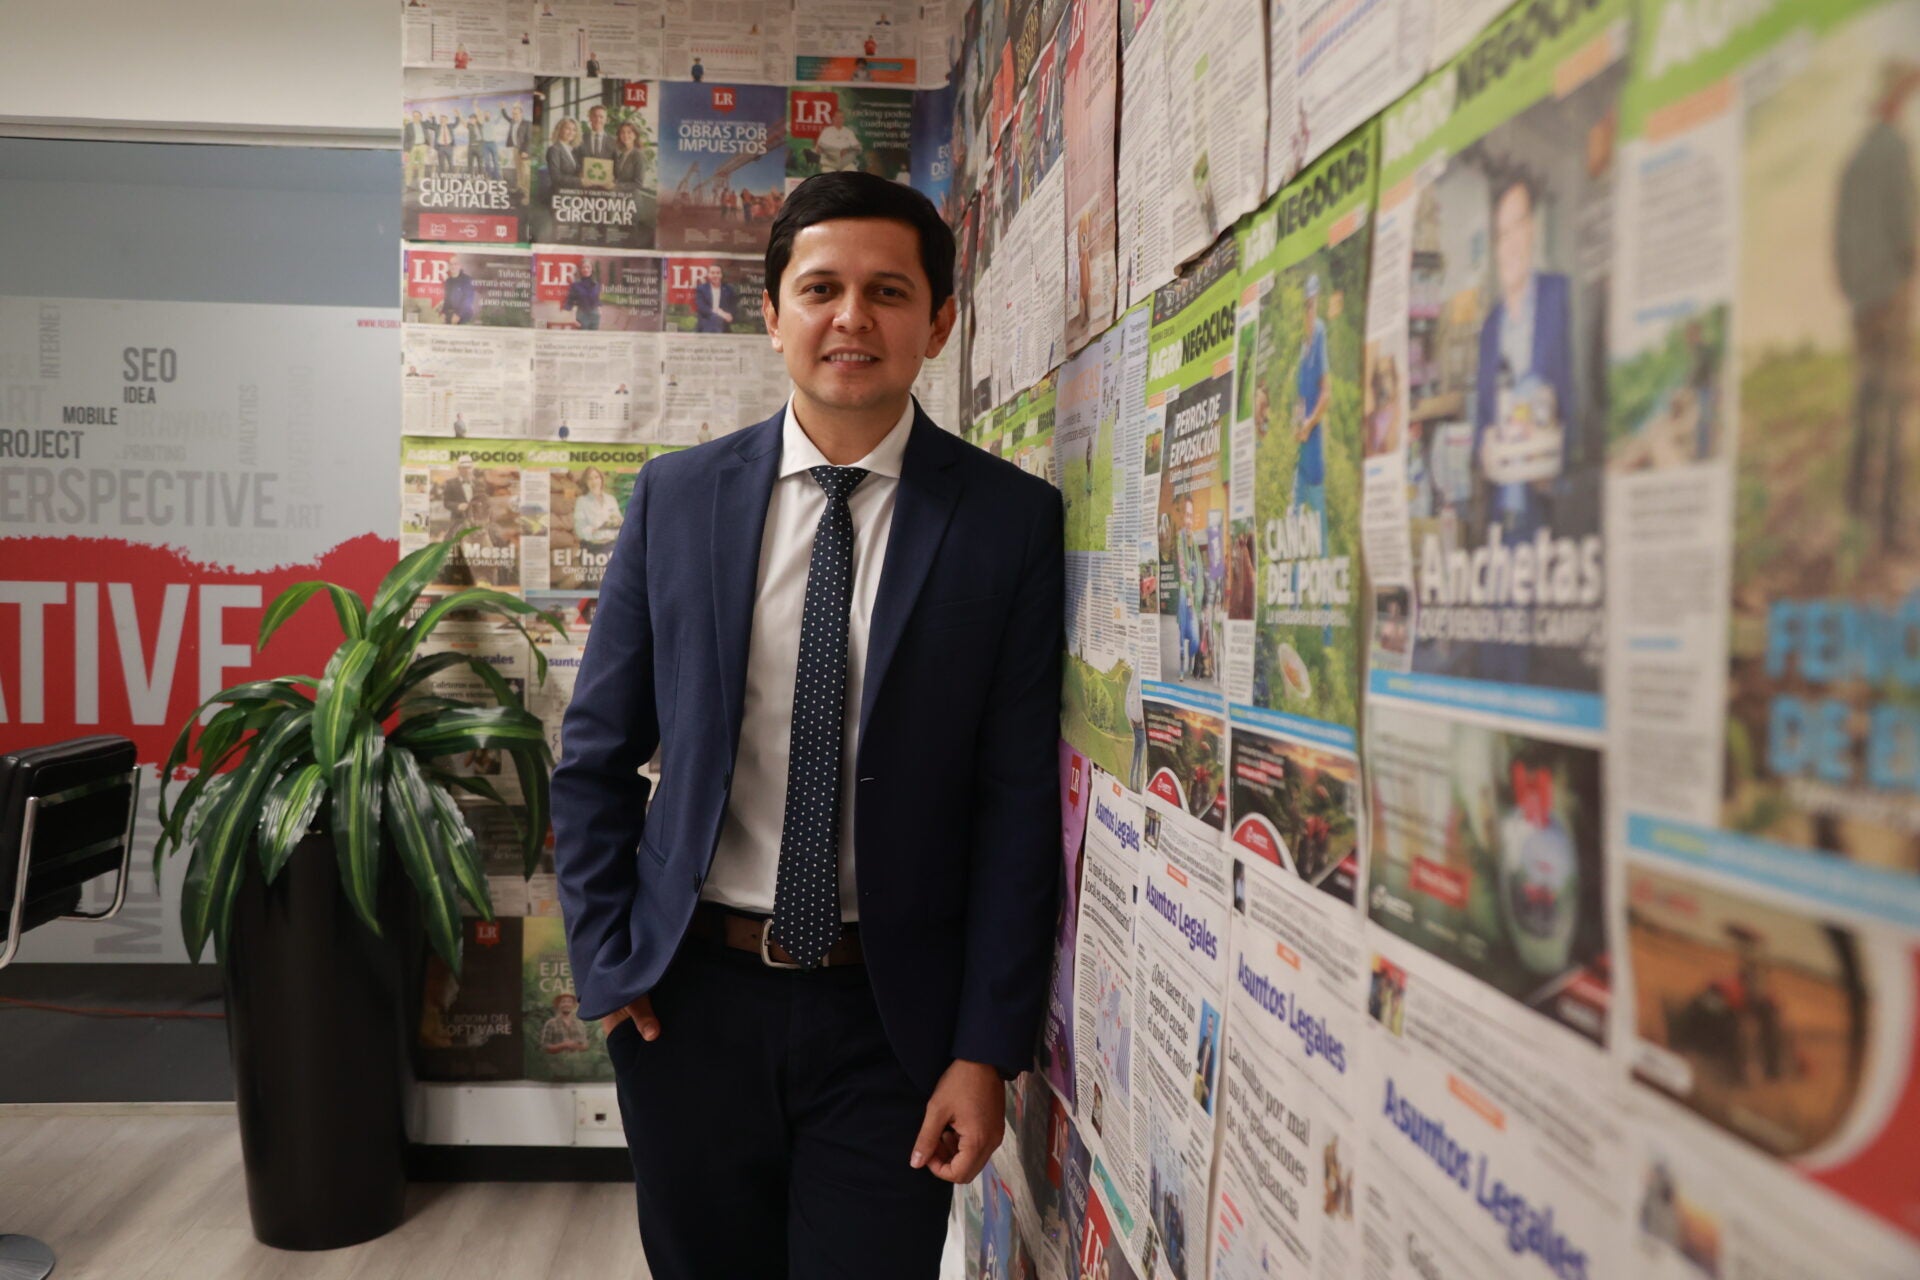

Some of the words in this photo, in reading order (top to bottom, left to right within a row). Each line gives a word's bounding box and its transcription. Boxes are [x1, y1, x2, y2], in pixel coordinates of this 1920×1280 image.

[626, 88, 645, 102] LR
[714, 92, 734, 106] LR
[795, 99, 833, 125] LR
[679, 124, 731, 139] OBRAS
[736, 127, 768, 140] POR
[678, 138, 768, 155] IMPUESTOS
[419, 177, 508, 197] CIUDADES
[419, 192, 511, 210] CAPITALES
[551, 194, 638, 214] ECONOMÍA
[555, 208, 633, 226] CIRCULAR
[412, 258, 449, 284] LR
[540, 261, 577, 286] LR
[672, 265, 708, 289] LR
[38, 302, 62, 380] INTERNET
[123, 345, 178, 384] SEO
[123, 386, 157, 405] IDEA
[62, 405, 119, 427] MOBILE
[238, 382, 260, 467] ANALYTICS
[1174, 399, 1208, 438] PERROS
[1207, 393, 1222, 424] DE
[0, 428, 85, 460] ROJECT
[1169, 423, 1221, 469] EXPOSICIÓN
[0, 465, 279, 528] ERSPECTIVE
[284, 503, 324, 530] ART
[463, 542, 516, 559] Messi
[553, 548, 571, 566] El
[1420, 522, 1603, 605] Anchetas
[0, 580, 262, 726] TIVE
[549, 656, 582, 668] sunto
[1070, 765, 1080, 794] LR
[1094, 795, 1115, 832] Asuntos
[1114, 811, 1140, 853] Legales
[1145, 875, 1177, 928] Asuntos
[1178, 902, 1218, 961] Legales
[477, 925, 498, 940] LR
[1165, 973, 1182, 1008] hacer
[1181, 994, 1189, 1014] si
[1187, 1001, 1196, 1024] un
[1149, 990, 1169, 1024] negocio
[1168, 1014, 1189, 1047] excede
[1238, 952, 1286, 1022] Asuntos
[1289, 993, 1346, 1075] Legales
[447, 1023, 513, 1037] OFTWARE
[1165, 1034, 1173, 1059] de
[1228, 1036, 1241, 1070] Las
[1265, 1089, 1286, 1123] por
[1287, 1110, 1310, 1147] mal
[1226, 1106, 1236, 1135] de
[1382, 1076, 1471, 1191] Asuntos
[1476, 1153, 1590, 1280] Legales
